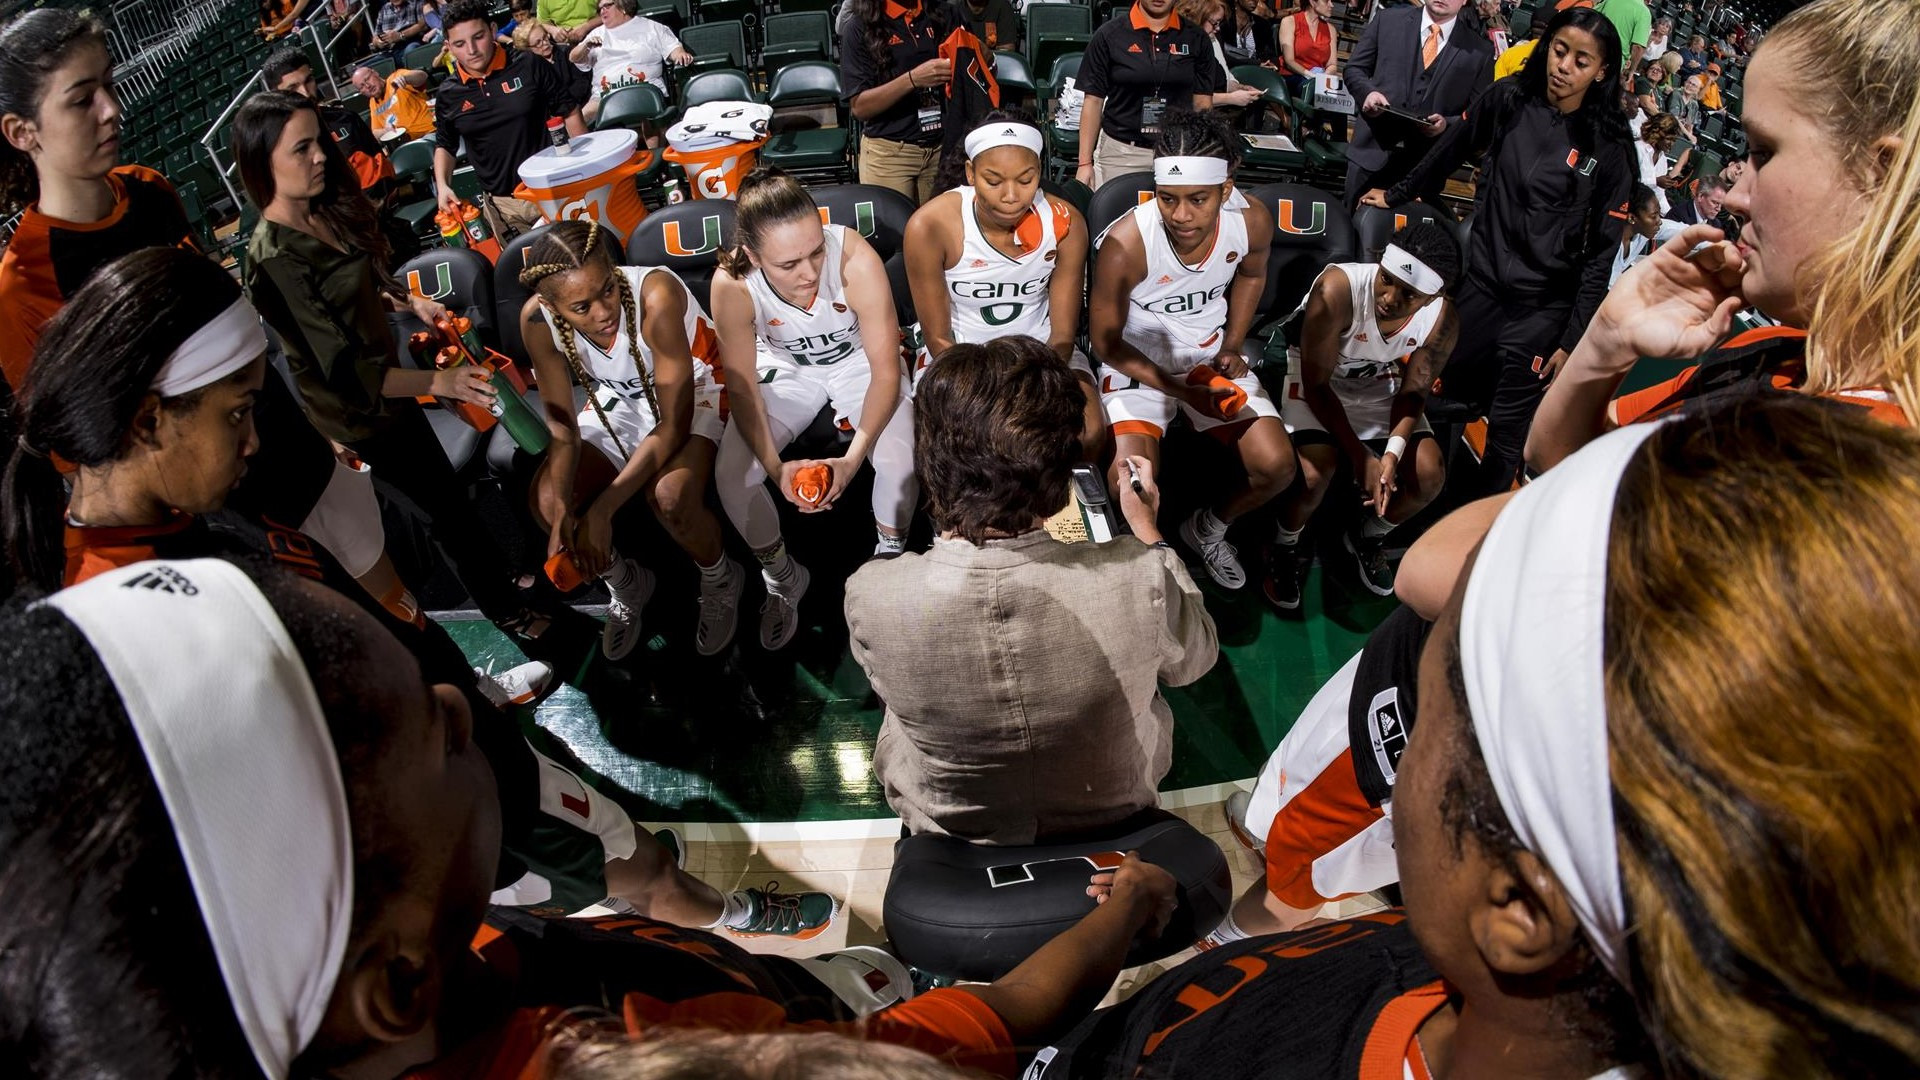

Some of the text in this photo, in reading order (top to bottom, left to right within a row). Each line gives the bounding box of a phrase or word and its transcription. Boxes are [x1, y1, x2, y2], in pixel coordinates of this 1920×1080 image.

[500, 77, 523, 95] U
[1325, 77, 1343, 91] U
[698, 167, 728, 200] G
[1278, 198, 1327, 235] U
[661, 214, 723, 257] U
[406, 261, 453, 301] U
